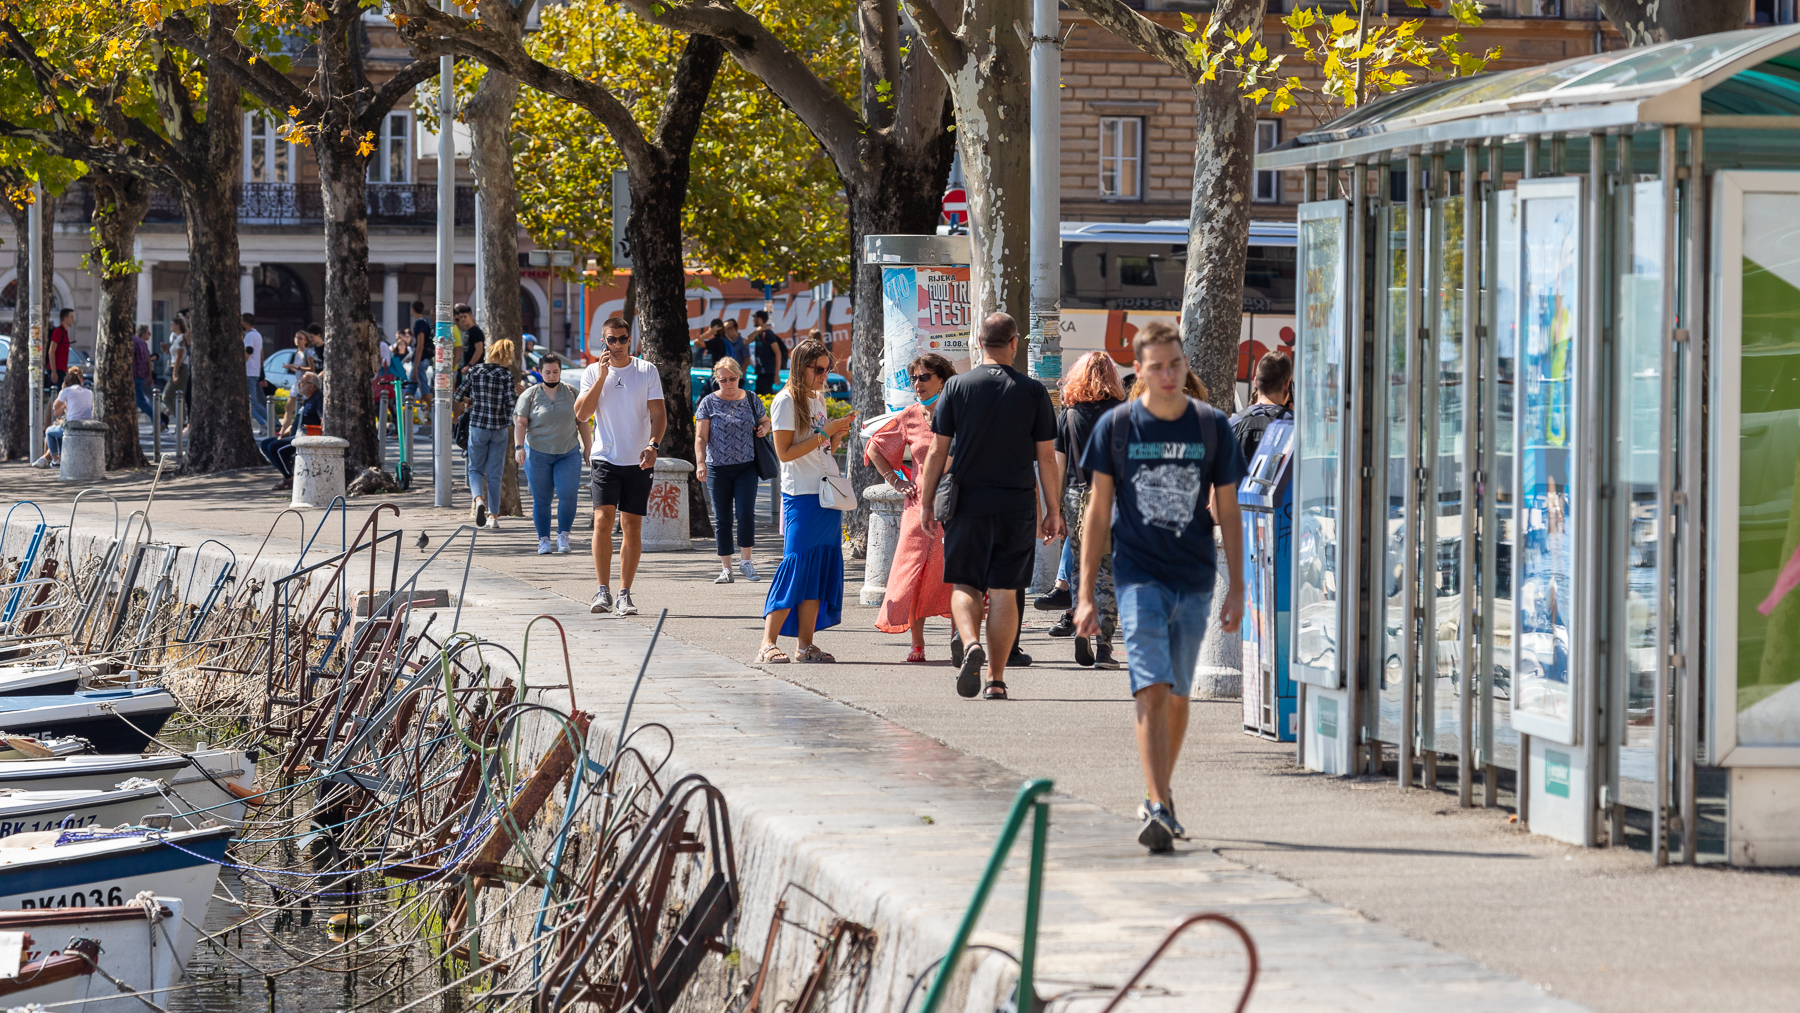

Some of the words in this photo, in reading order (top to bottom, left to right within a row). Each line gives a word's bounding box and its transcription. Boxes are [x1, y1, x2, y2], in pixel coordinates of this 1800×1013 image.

[928, 274, 956, 282] RIJEKA
[928, 282, 949, 301] FOOD
[930, 299, 971, 326] FEST
